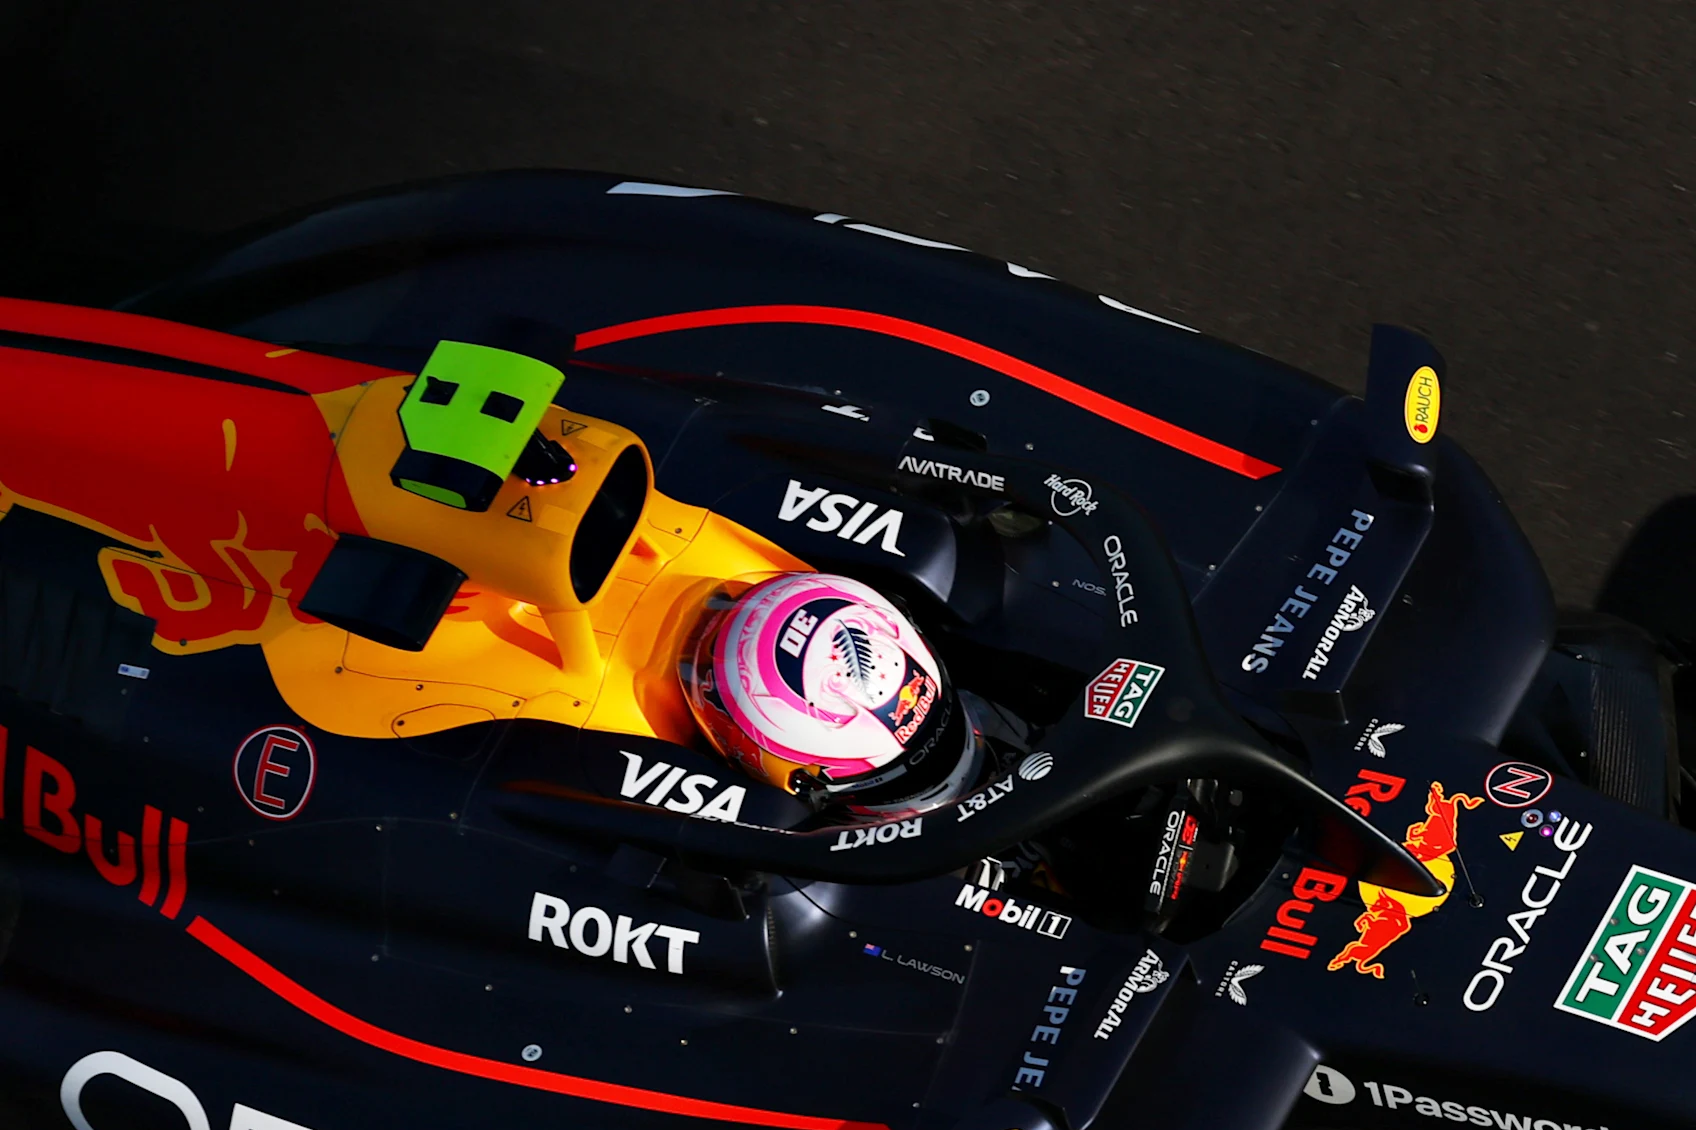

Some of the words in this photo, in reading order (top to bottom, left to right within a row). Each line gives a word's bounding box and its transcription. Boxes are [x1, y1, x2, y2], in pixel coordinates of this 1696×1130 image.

[1414, 374, 1434, 426] RAUCH
[898, 455, 1006, 493] AVATRADE
[1043, 473, 1070, 497] Hard
[1066, 486, 1098, 516] Rock
[777, 478, 906, 557] VISA
[1308, 508, 1375, 586] PEPE
[1103, 534, 1139, 629] ORACLE
[778, 607, 819, 659] 30
[1241, 583, 1320, 675] JEANS
[1092, 661, 1130, 716] HEUER
[1113, 669, 1156, 719] TAG
[909, 702, 953, 766] ORACL
[1353, 717, 1380, 752] CASTORE
[253, 733, 300, 810] E
[617, 748, 749, 824] VISA
[956, 773, 1015, 823] AT&T
[1344, 767, 1408, 819] Re
[20, 744, 190, 921] Bull
[829, 816, 924, 853] ROKT
[1149, 810, 1181, 896] ORACLE
[527, 891, 700, 976] ROKT
[954, 883, 1042, 931] Mobil
[1259, 866, 1348, 960] Bull
[1462, 817, 1594, 1013] ORACLE
[896, 954, 966, 986] LAWSON
[1576, 883, 1671, 1008] TAG
[1030, 965, 1087, 1046] PEPE
[1214, 959, 1239, 998] CASTORE
[1010, 1050, 1050, 1092] JE
